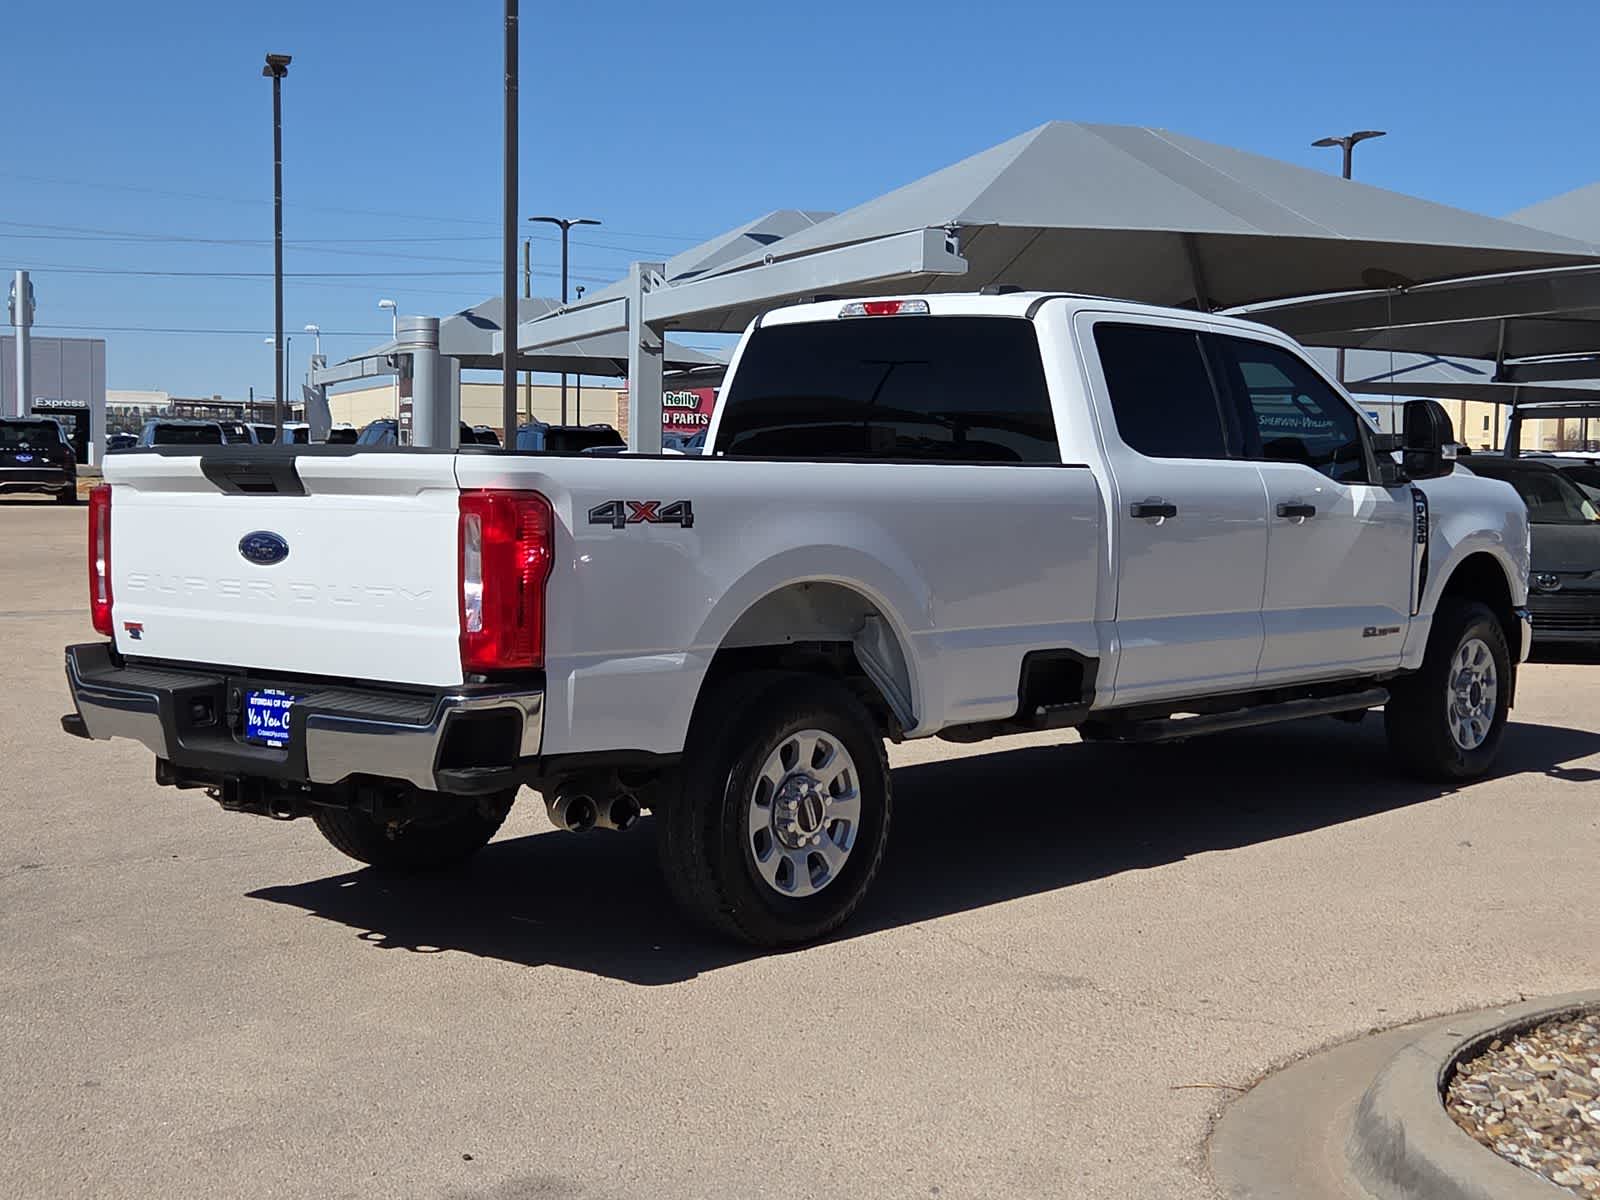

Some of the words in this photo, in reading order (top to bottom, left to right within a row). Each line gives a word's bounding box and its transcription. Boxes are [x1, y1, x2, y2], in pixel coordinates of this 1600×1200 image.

[35, 398, 86, 408] Express
[663, 391, 699, 408] Reilly
[672, 413, 708, 425] PARTS
[127, 572, 280, 600] SUPER
[287, 581, 433, 611] DUTY
[248, 708, 262, 726] Yes
[263, 710, 281, 727] You
